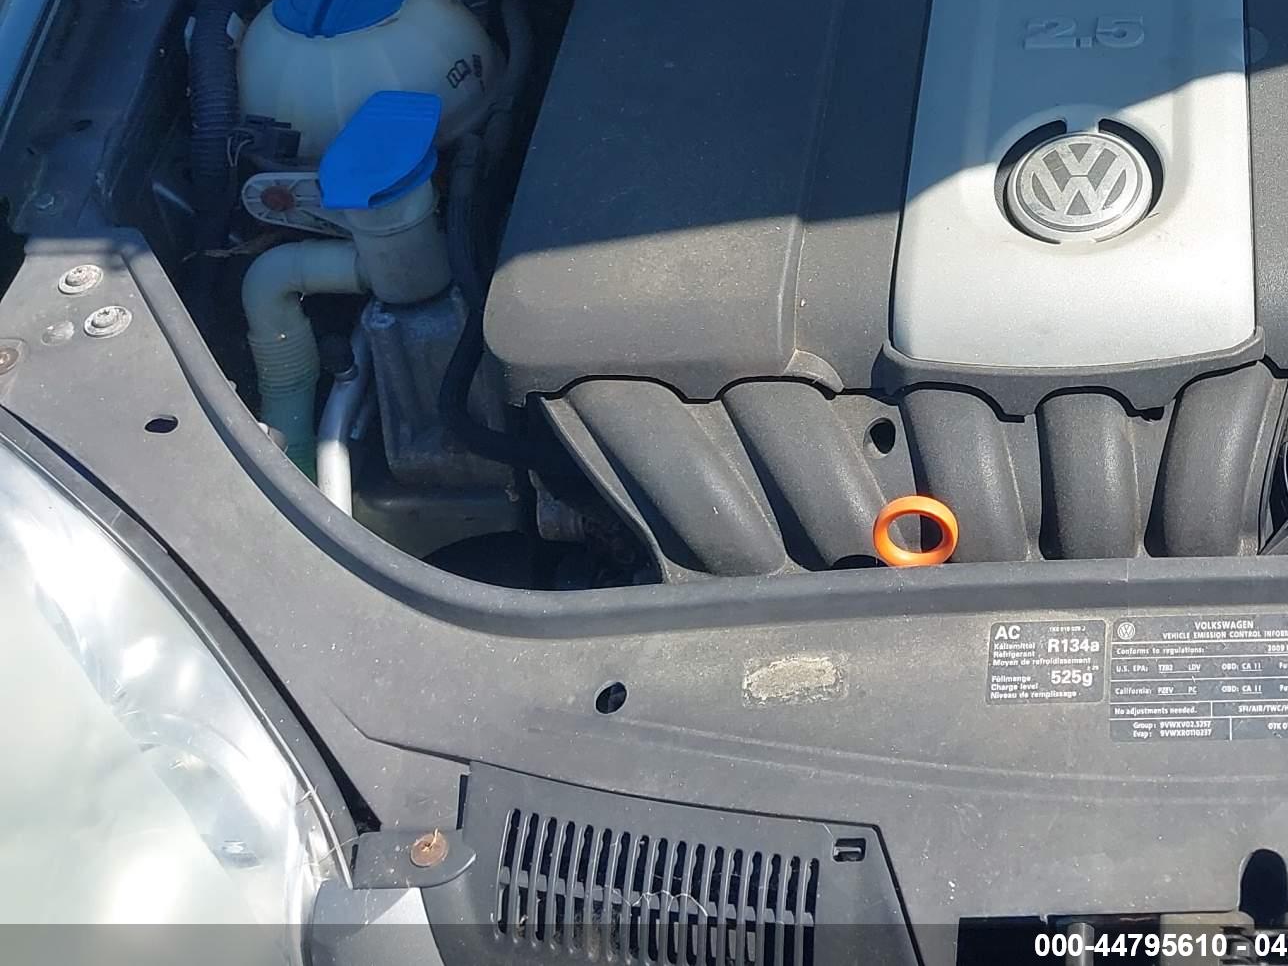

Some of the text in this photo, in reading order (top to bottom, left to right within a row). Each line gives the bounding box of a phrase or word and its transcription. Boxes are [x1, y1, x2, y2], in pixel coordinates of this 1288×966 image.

[1022, 17, 1145, 50] 2.5
[1014, 136, 1146, 233] VW
[1194, 620, 1254, 630] VOLKSWAGEN
[995, 625, 1020, 640] AC
[1117, 622, 1136, 640] VW
[1194, 632, 1226, 640] EMISSION
[1047, 638, 1100, 653] R134a
[1163, 646, 1204, 656] regulations:
[992, 675, 1031, 683] Füllmenge
[1051, 670, 1093, 687] 525g
[1031, 690, 1076, 699] remplissage
[1115, 687, 1152, 695] California:
[1126, 706, 1168, 716] adjustments
